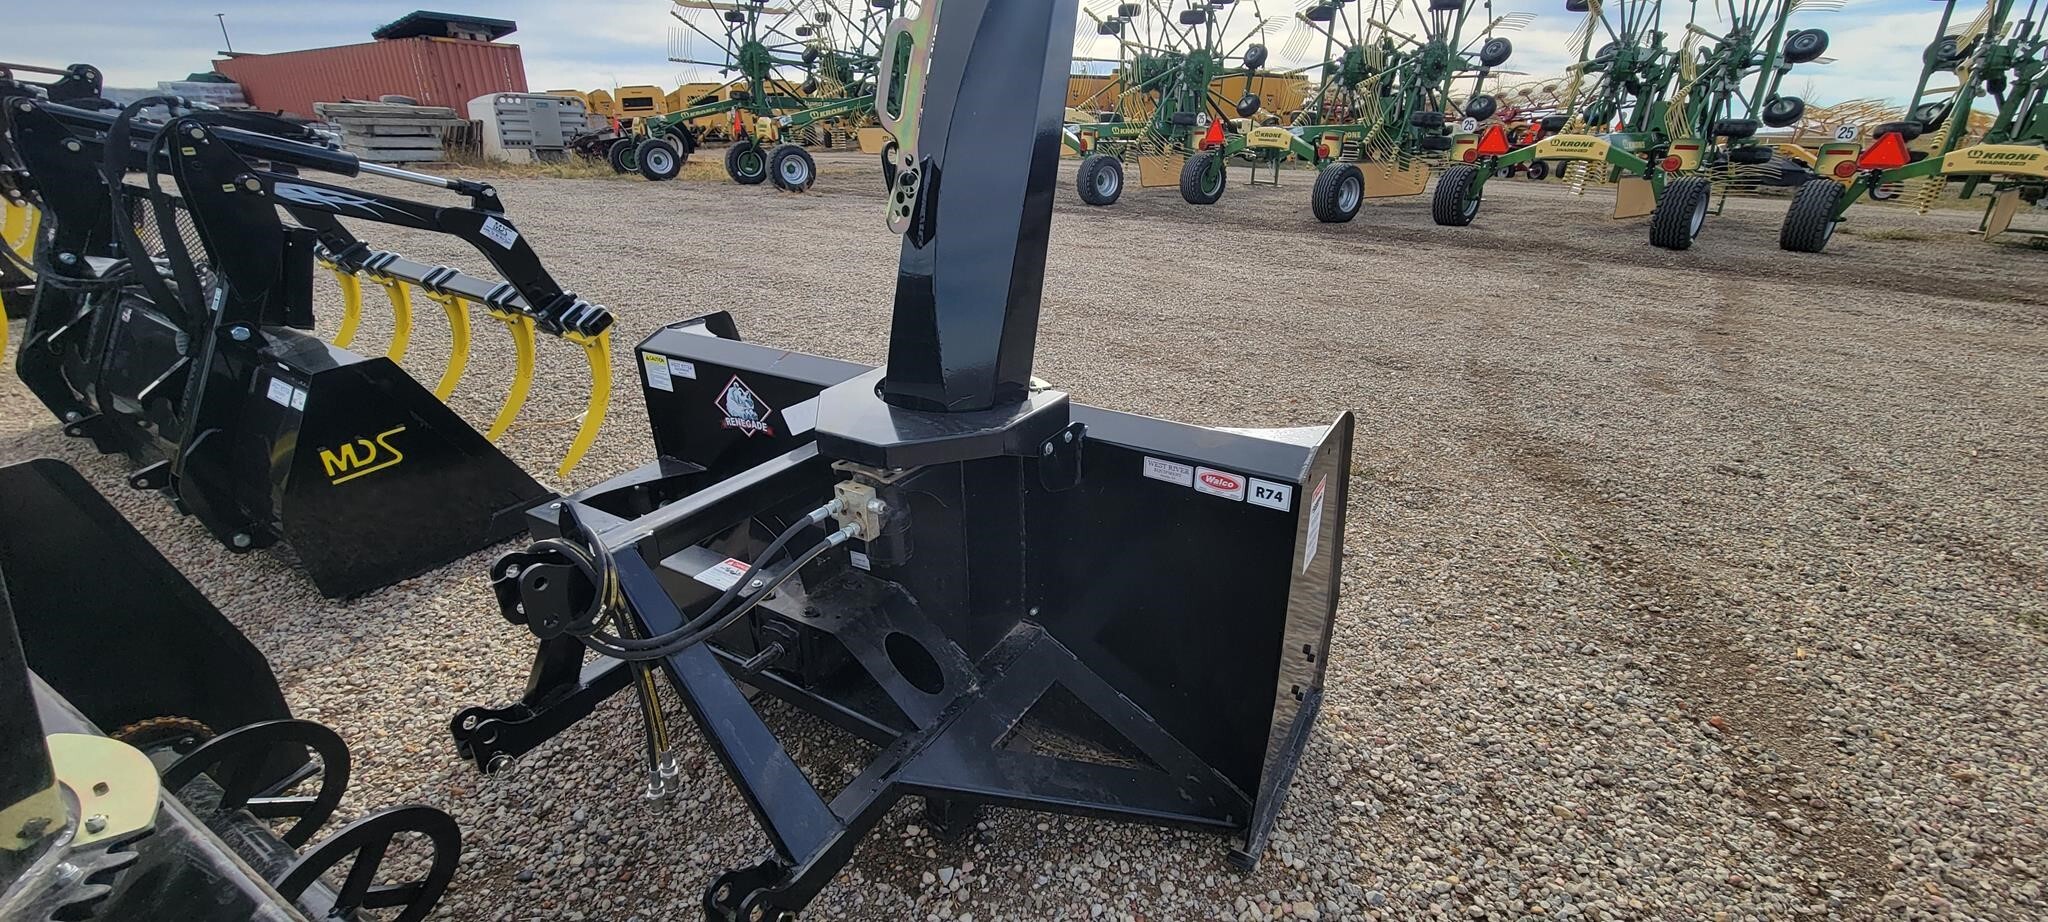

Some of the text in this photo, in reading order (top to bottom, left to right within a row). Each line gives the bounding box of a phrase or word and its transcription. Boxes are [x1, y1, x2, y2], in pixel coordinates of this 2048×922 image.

[820, 106, 848, 118] KRONE
[1463, 119, 1475, 131] 25
[1838, 127, 1854, 140] 25
[1983, 152, 2040, 161] KRONE
[725, 416, 768, 432] RENEGADE
[319, 426, 406, 485] MDS
[1147, 459, 1190, 475] WEST RIVER
[1205, 474, 1235, 488] Walco
[1255, 486, 1283, 503] R74
